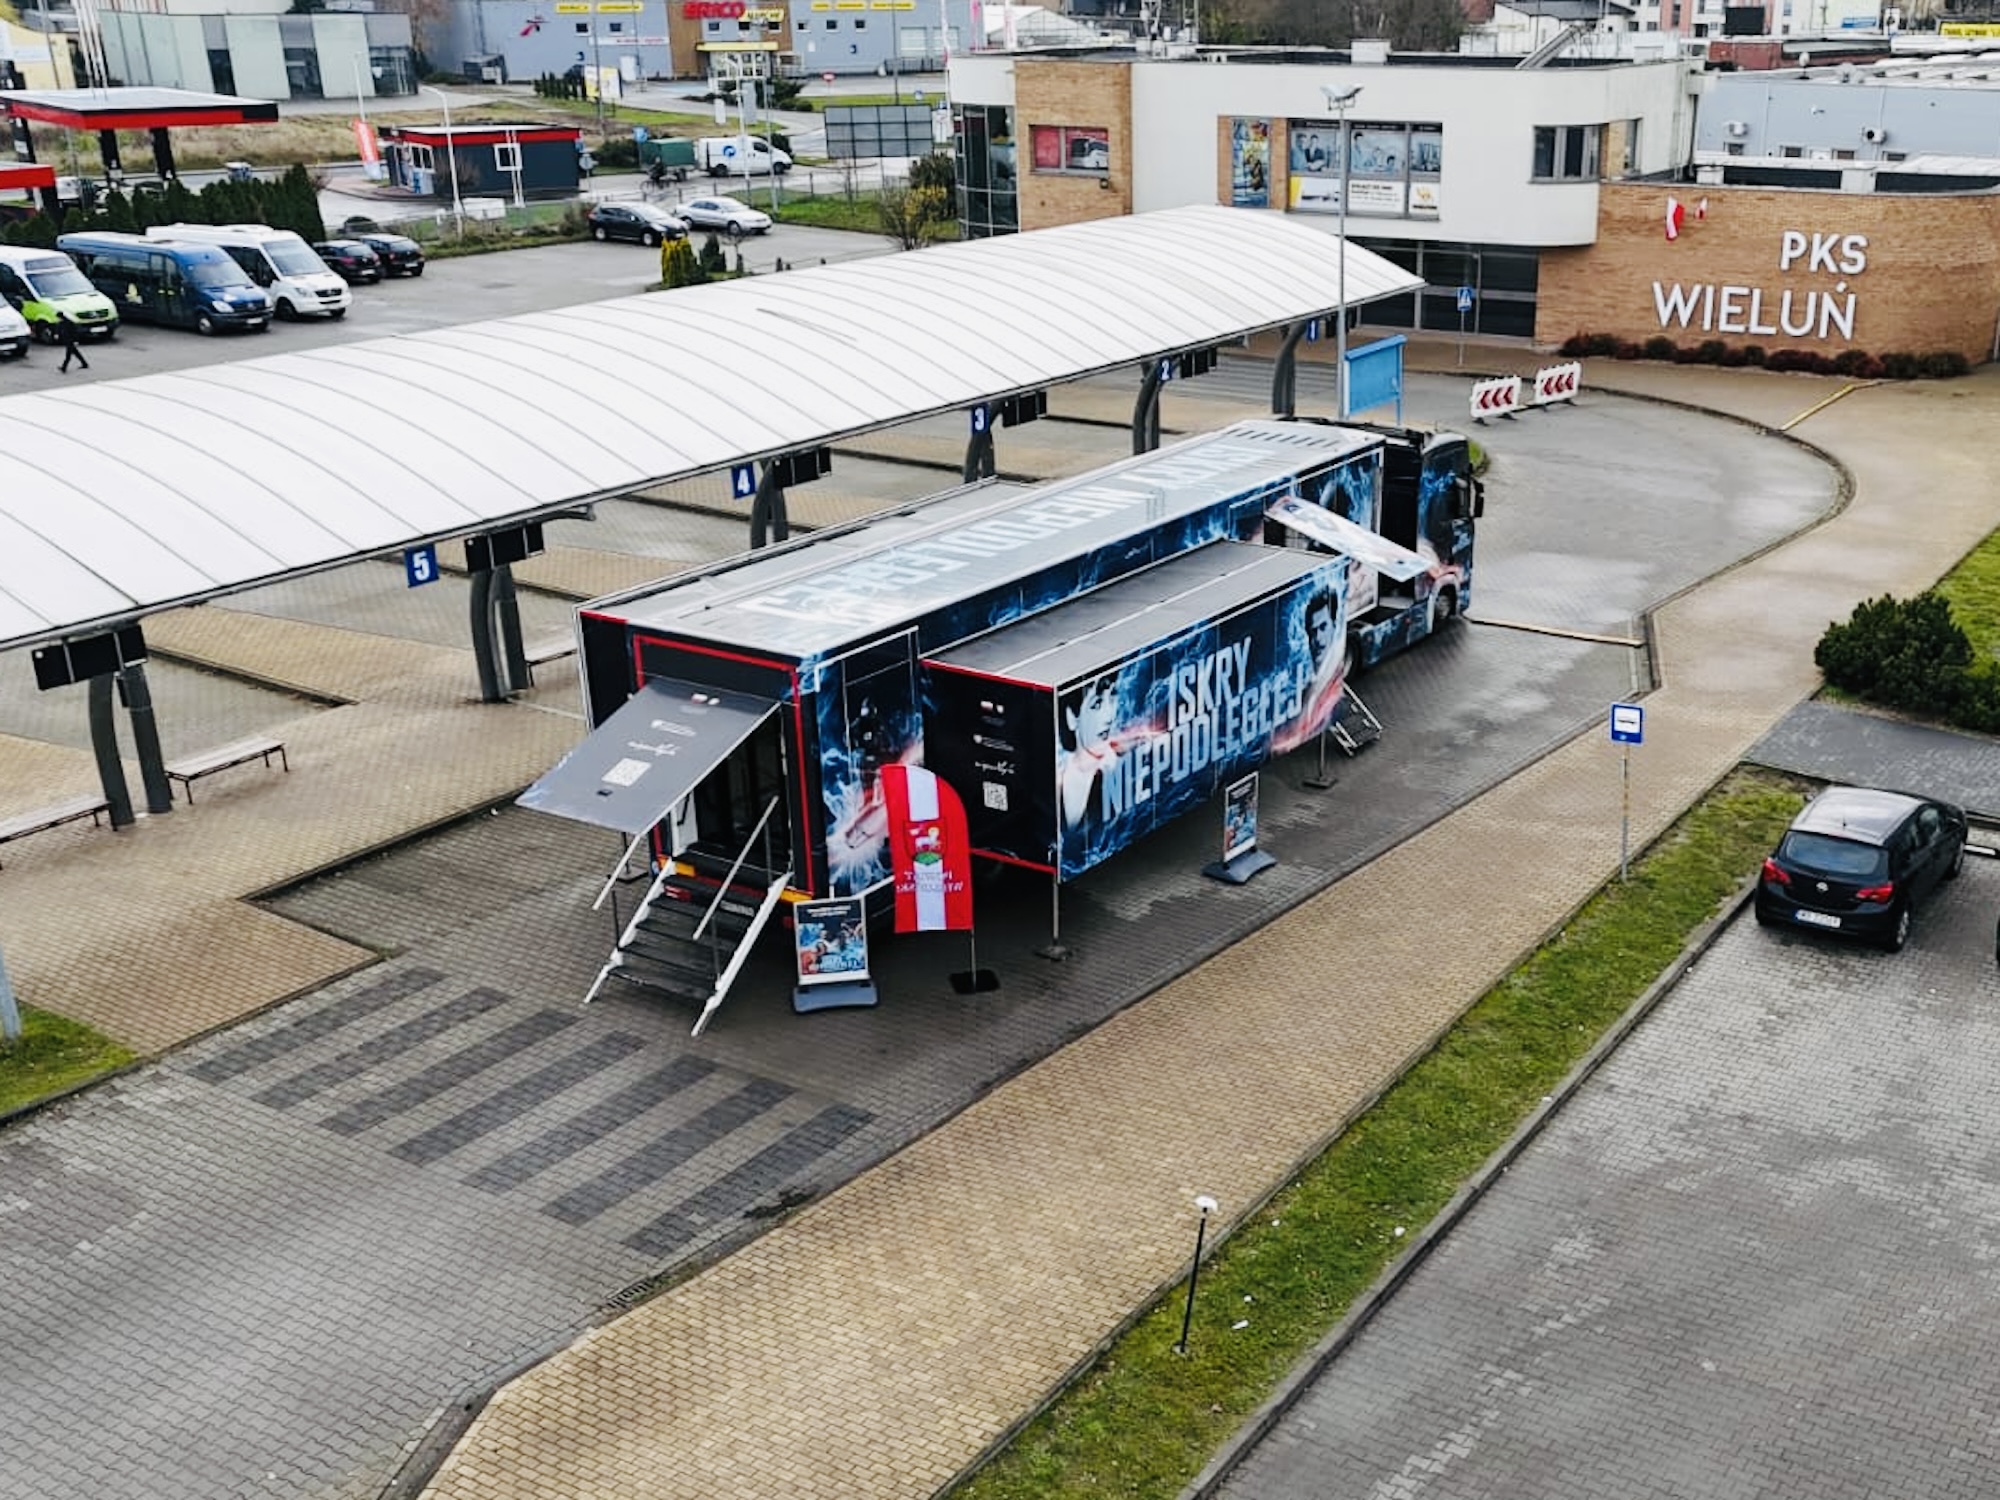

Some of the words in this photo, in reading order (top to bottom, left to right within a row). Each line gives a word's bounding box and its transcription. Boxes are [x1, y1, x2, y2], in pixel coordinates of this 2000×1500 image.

[1780, 231, 1868, 275] PKS
[1652, 280, 1857, 340] WIELUŃ
[1310, 320, 1316, 340] 1
[1161, 359, 1170, 381] 2
[974, 407, 985, 431] 3
[737, 468, 751, 494] 4
[412, 551, 430, 581] 5
[1168, 636, 1252, 731] ISKRY
[1102, 662, 1304, 823] NIEPODLEGŁEJ
